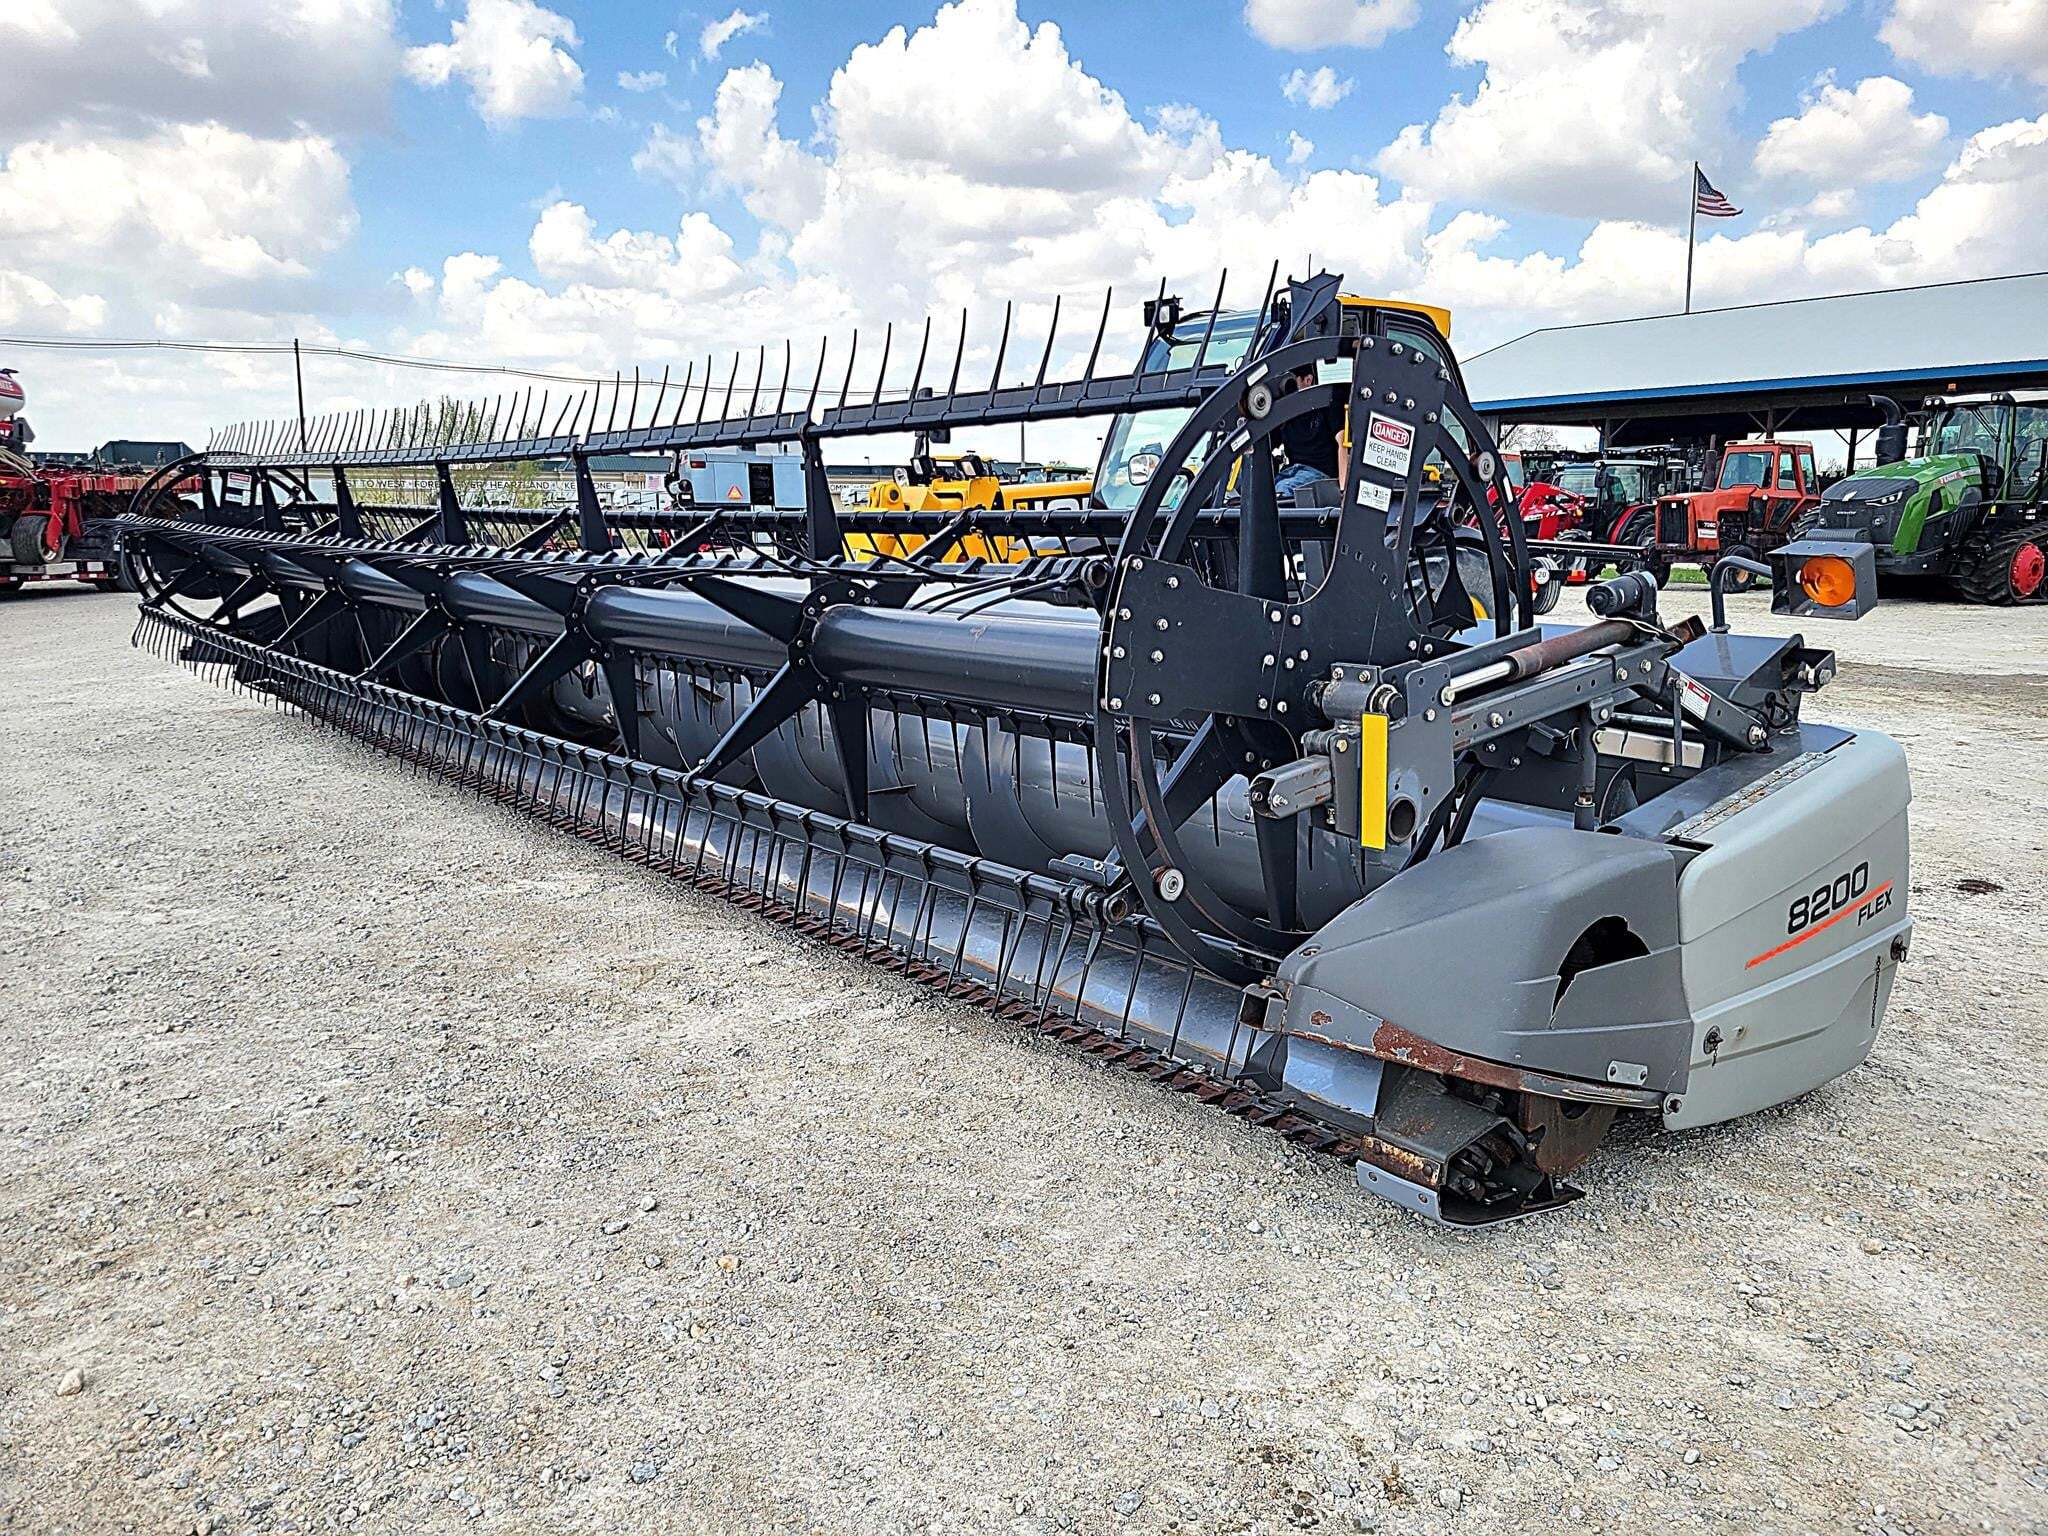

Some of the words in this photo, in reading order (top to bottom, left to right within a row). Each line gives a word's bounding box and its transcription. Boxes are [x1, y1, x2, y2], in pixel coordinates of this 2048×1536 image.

[1375, 423, 1407, 445] DANGER
[1368, 441, 1386, 454] KEEP
[1386, 447, 1408, 462] HANDS
[1376, 455, 1397, 469] CLEAR
[331, 479, 359, 488] EST
[360, 479, 375, 488] TO
[377, 479, 406, 488] WEST
[490, 480, 550, 489] HEARTLAND
[1787, 861, 1869, 935] 8200
[1857, 887, 1893, 927] FLEX
